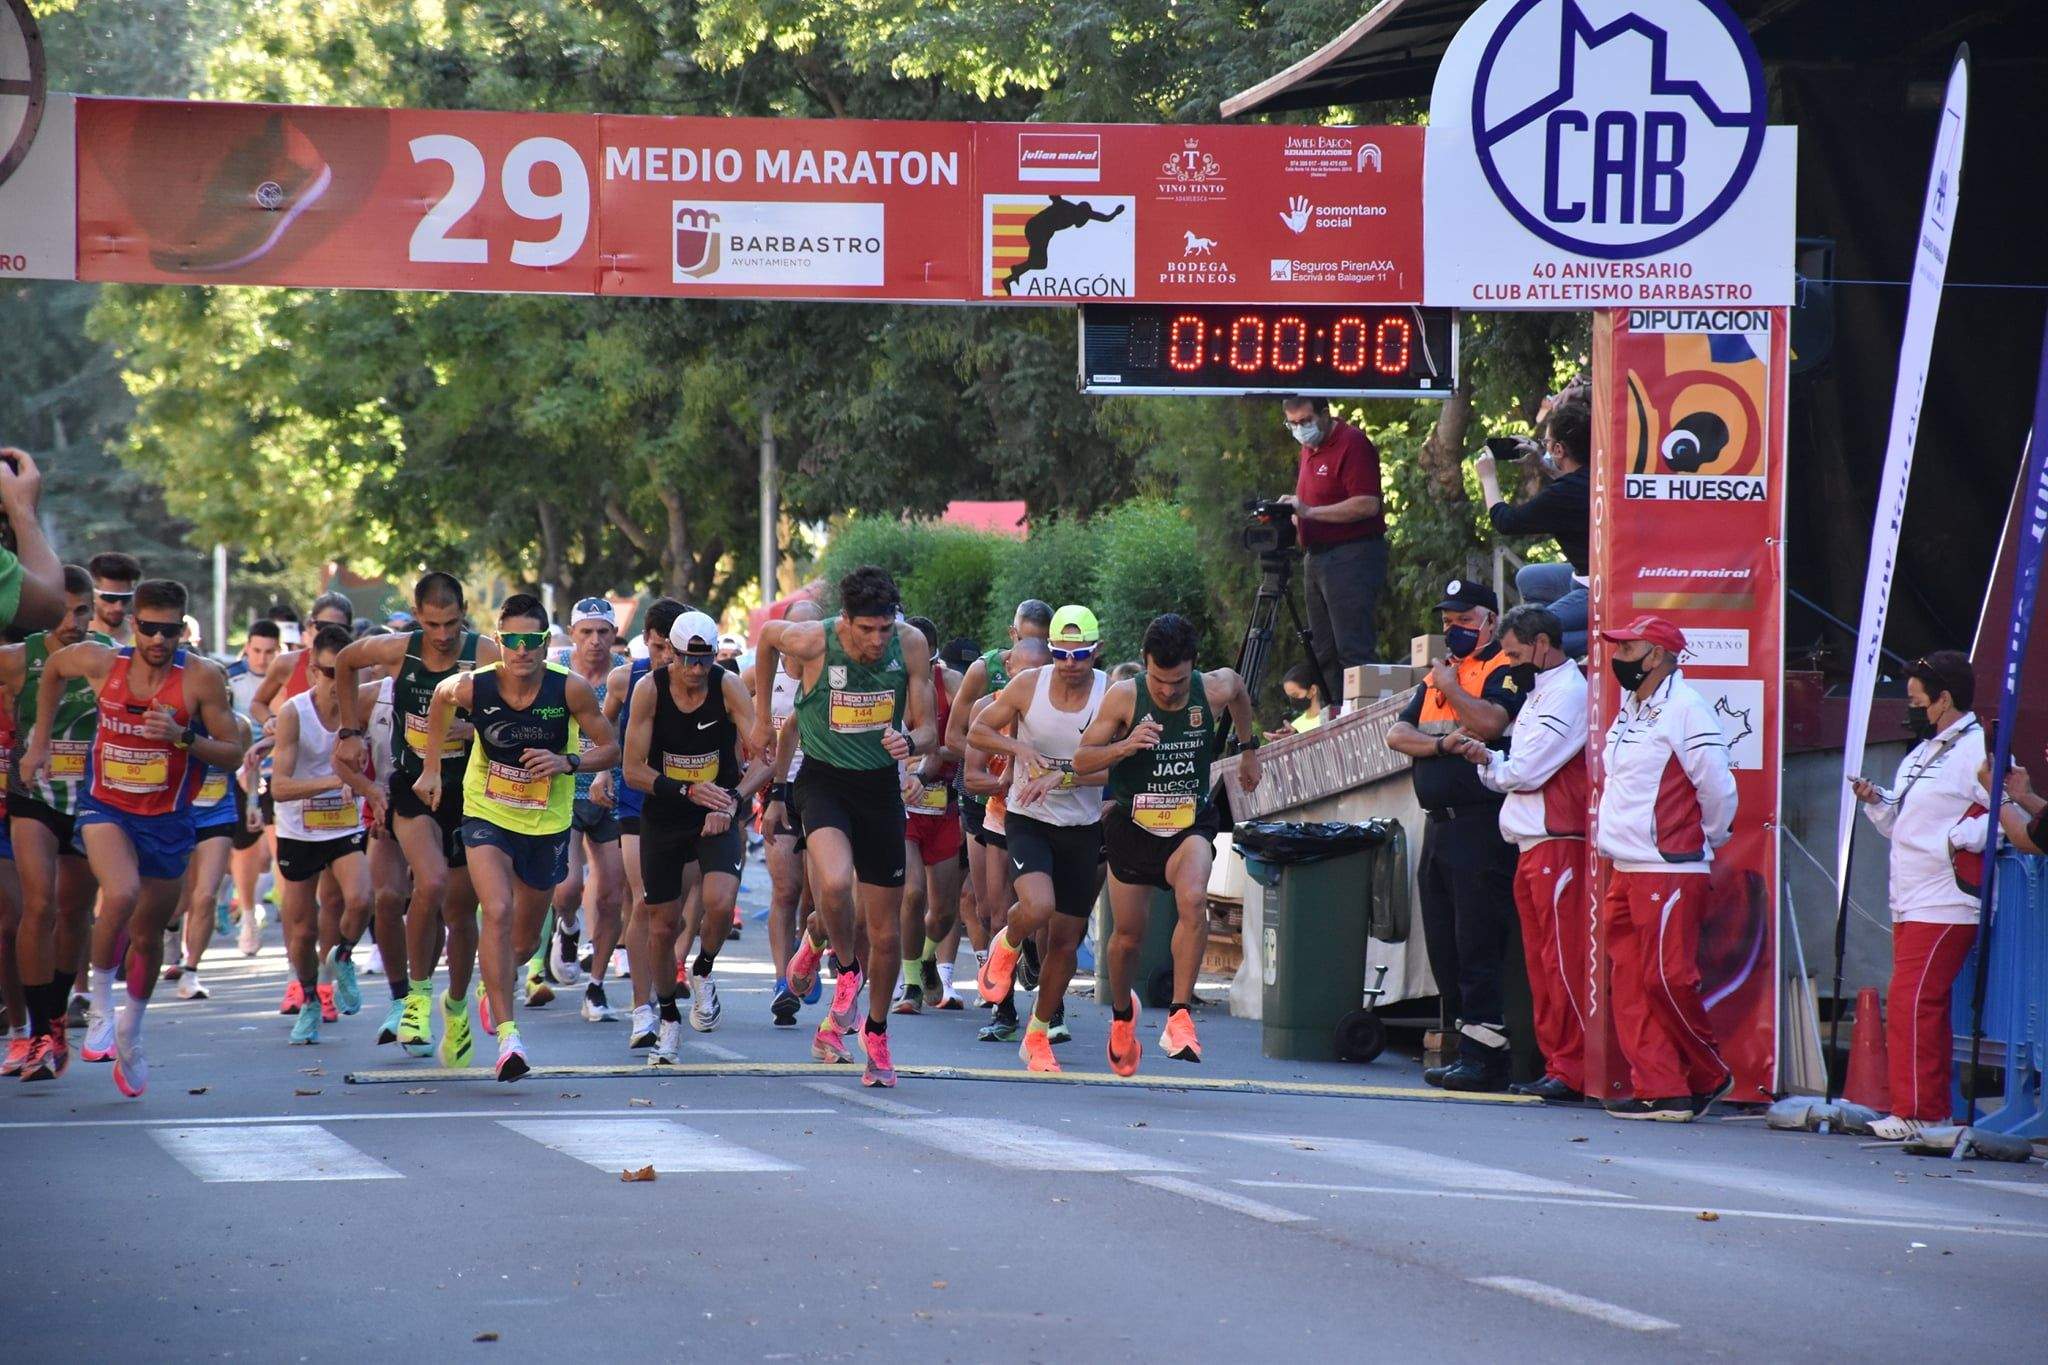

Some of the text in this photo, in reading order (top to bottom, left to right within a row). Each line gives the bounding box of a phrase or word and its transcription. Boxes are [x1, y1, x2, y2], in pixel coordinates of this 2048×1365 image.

[606, 147, 958, 185] MEDIO MARATON
[1544, 110, 1686, 225] CAB
[1159, 184, 1224, 192] VINO TINTO
[408, 134, 590, 267] 29
[1316, 205, 1387, 216] somontano
[1316, 217, 1352, 228] social
[730, 235, 881, 254] BARBASTRO
[731, 258, 811, 267] AYUNTAMIENTO
[1167, 262, 1228, 271] BODEGA
[1292, 260, 1394, 272] Seguros PirenAXA
[1325, 273, 1335, 281] de
[1377, 273, 1386, 281] 11
[1532, 263, 1692, 279] 40 ANIVERSARIO
[1160, 274, 1236, 283] PIRINEOS
[1027, 274, 1125, 296] ARAGÓN
[1472, 284, 1752, 300] CLUB ATLETISMO BARBASTRO
[1629, 311, 1768, 330] DIPUTACION
[1626, 480, 1766, 500] DE HUESCA
[1690, 568, 1750, 578] mairal
[1169, 751, 1196, 760] CISNE
[1153, 761, 1195, 776] JACA
[1158, 811, 1171, 820] 40
